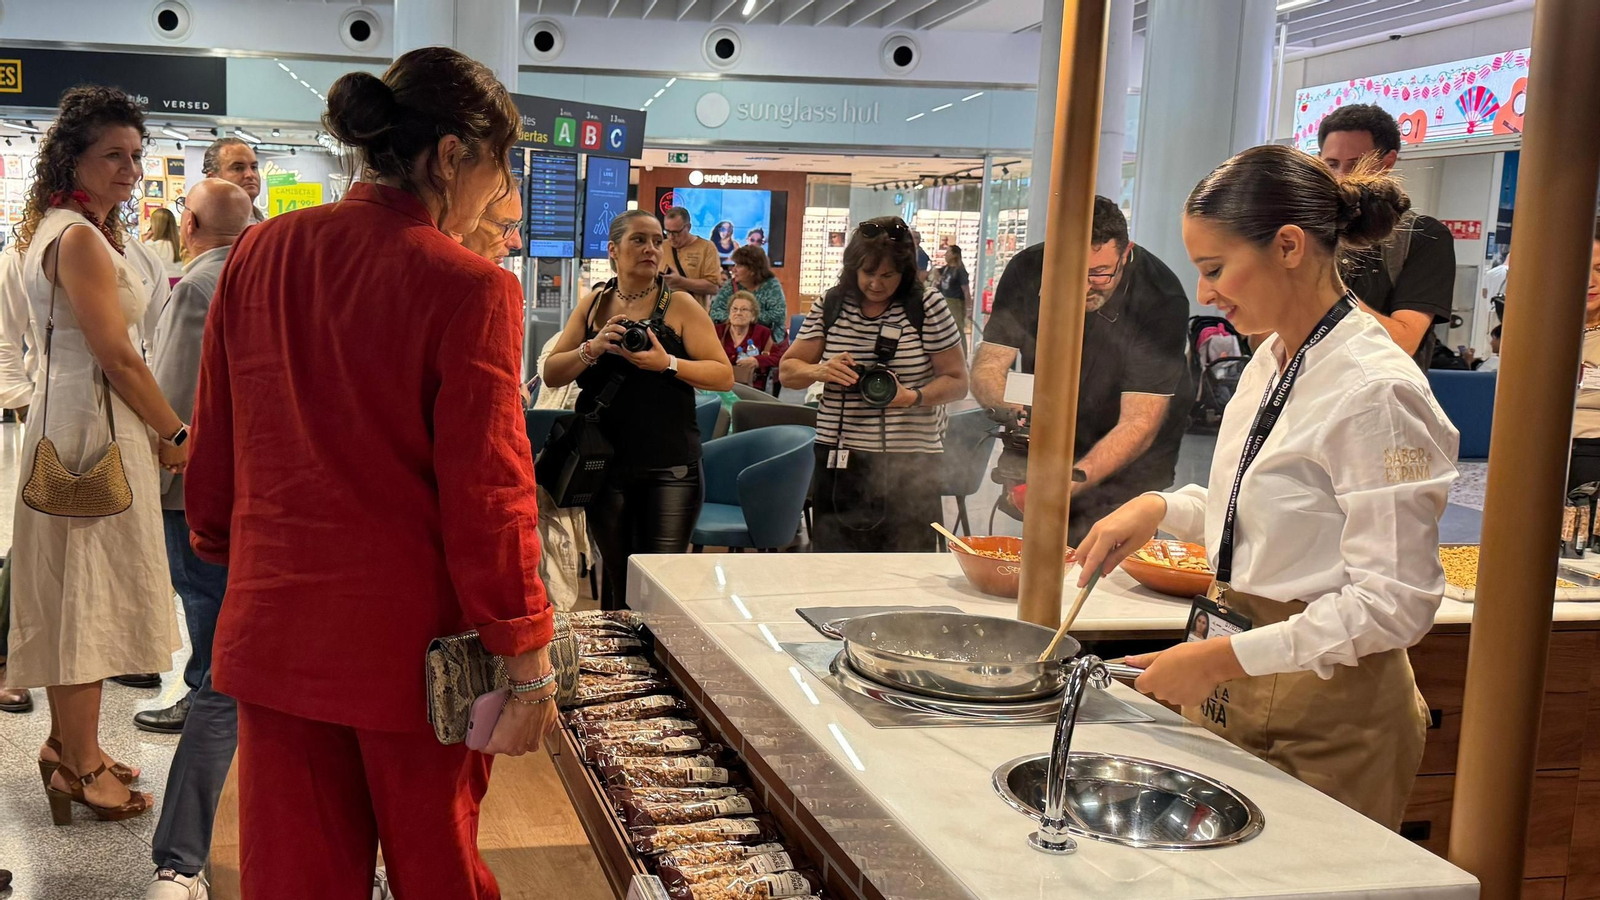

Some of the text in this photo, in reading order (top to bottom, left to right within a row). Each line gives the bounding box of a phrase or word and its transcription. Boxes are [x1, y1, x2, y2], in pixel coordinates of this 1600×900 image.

[163, 100, 210, 110] VERSED
[737, 96, 879, 129] sunglass hut
[517, 130, 548, 143] uertas
[558, 122, 571, 143] A
[584, 125, 597, 145] B
[610, 128, 623, 148] C
[704, 172, 758, 186] sunglass hut
[275, 187, 316, 196] CAMISETAS
[1272, 324, 1329, 408] enriquetomas.com
[1384, 447, 1428, 465] SABOR
